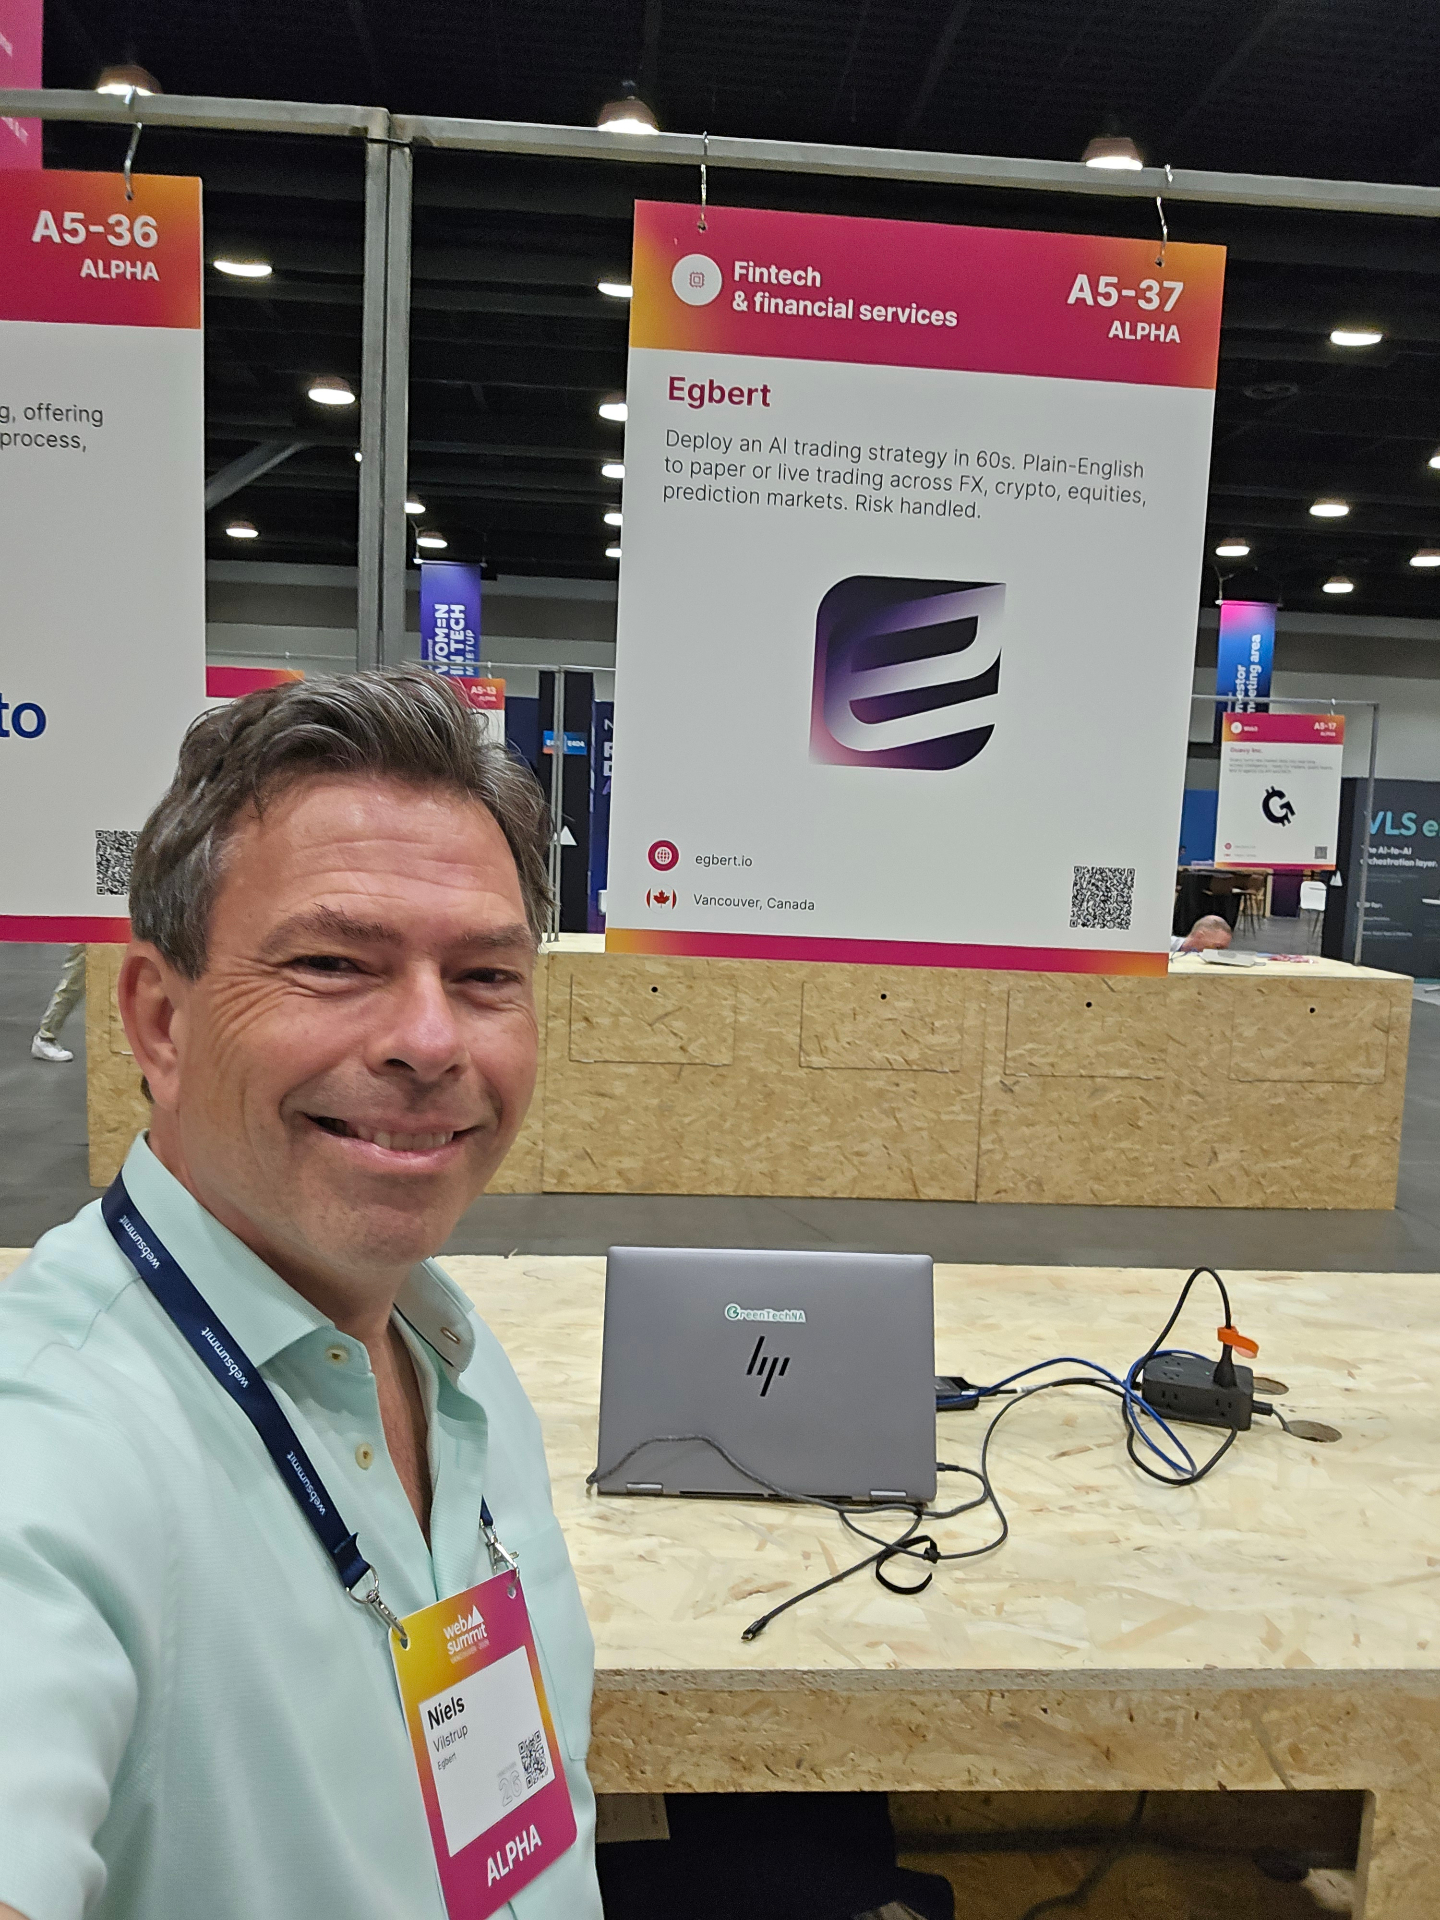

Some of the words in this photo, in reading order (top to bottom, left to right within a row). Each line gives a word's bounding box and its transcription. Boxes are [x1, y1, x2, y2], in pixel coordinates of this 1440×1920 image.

[31, 209, 159, 249] A5-36
[79, 257, 160, 282] ALPHA
[733, 260, 822, 288] Fintech
[732, 290, 748, 312] &
[754, 291, 854, 320] financial
[859, 302, 958, 327] services
[1066, 273, 1184, 313] A5-37
[1108, 320, 1181, 344] ALPHA
[668, 375, 771, 410] Egbert
[23, 402, 104, 428] offering
[0, 432, 87, 453] process,
[665, 428, 733, 455] Deploy
[739, 437, 762, 454] an
[768, 436, 787, 455] AI
[794, 438, 861, 464] trading
[868, 446, 948, 470] strategy
[953, 448, 970, 467] in
[975, 450, 1016, 470] 60s.
[1023, 453, 1145, 481] Plain-English
[664, 456, 684, 474] to
[689, 460, 747, 480] paper
[752, 465, 772, 480] or
[777, 462, 810, 483] live
[816, 466, 884, 491] trading
[890, 472, 953, 492] across
[958, 474, 989, 498] FX,
[994, 480, 1062, 502] crypto,
[1068, 484, 1147, 508] equities,
[663, 483, 760, 506] prediction
[766, 490, 849, 512] markets.
[855, 493, 894, 514] Risk
[900, 496, 982, 520] handled.
[449, 604, 466, 654] TECH
[1249, 634, 1262, 663] area
[695, 854, 753, 868] egbert.io
[693, 893, 762, 911] Vancouver,
[766, 897, 815, 911] Canada
[119, 1213, 161, 1270] websummit
[201, 1326, 251, 1389] websummit
[286, 1450, 328, 1517] websummit
[442, 1613, 468, 1640] web
[446, 1622, 488, 1655] summit
[426, 1696, 465, 1731] Niels
[432, 1725, 469, 1753] Vilstrup
[437, 1752, 458, 1771] Egbert
[499, 1769, 523, 1807] 26
[486, 1823, 543, 1888] ALPHA
